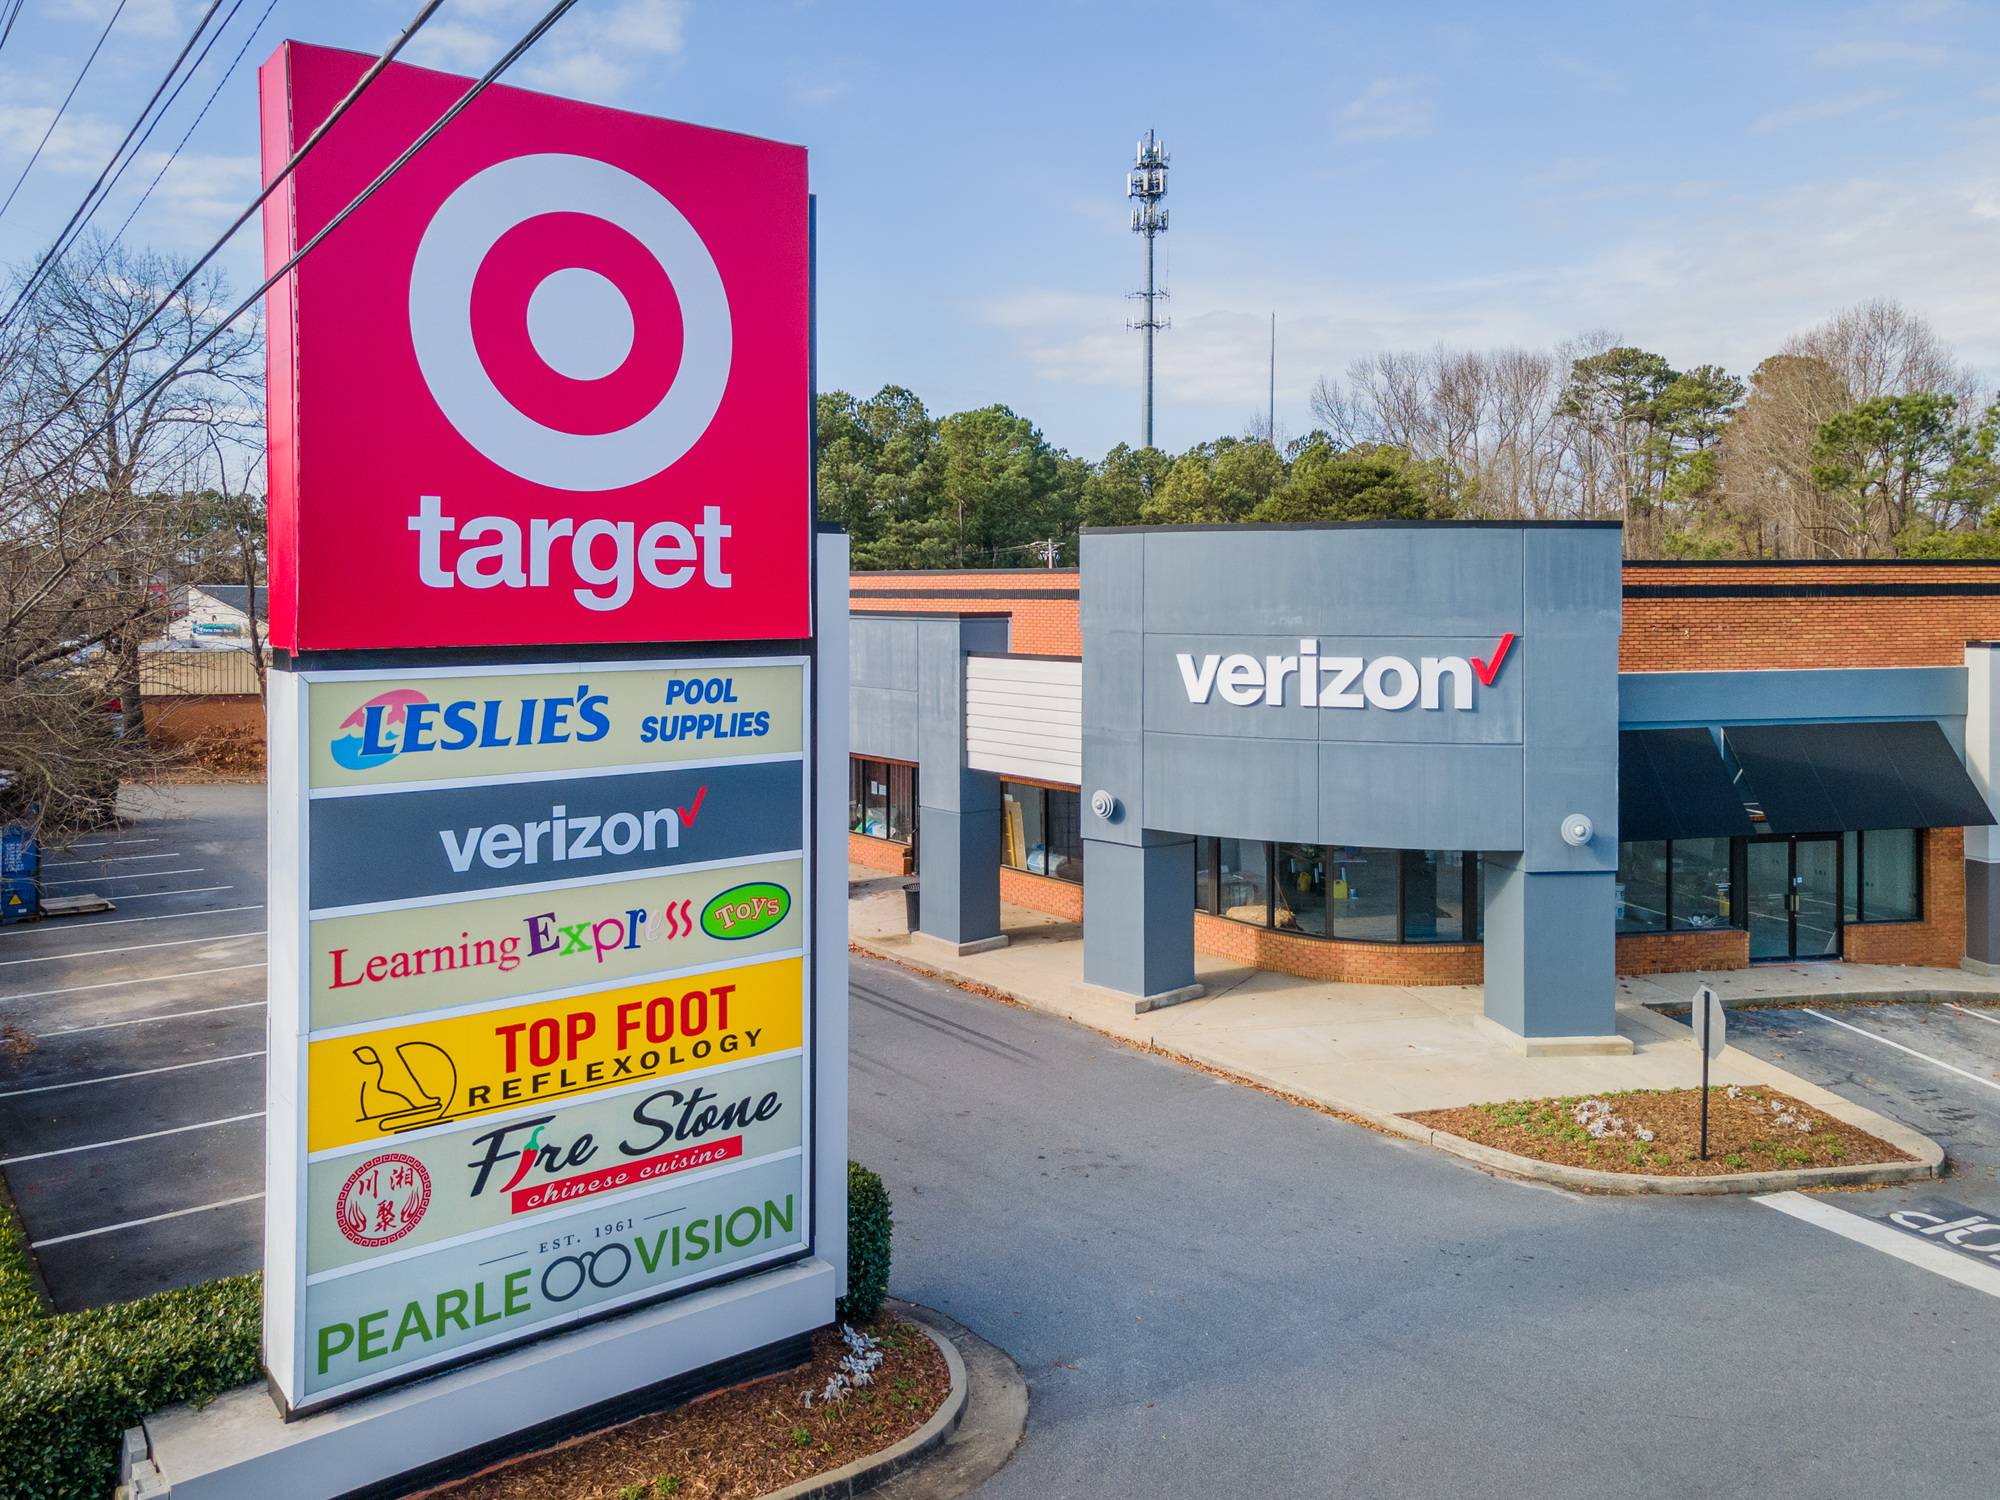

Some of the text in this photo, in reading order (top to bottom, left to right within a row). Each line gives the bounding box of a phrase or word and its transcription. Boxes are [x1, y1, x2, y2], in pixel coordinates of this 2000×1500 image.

[407, 495, 733, 612] target
[665, 677, 738, 705] POOL
[1175, 638, 1473, 710] verizon
[359, 685, 611, 756] LESLIE'S
[639, 710, 770, 744] SUPPLIES
[439, 804, 680, 873] verizon
[328, 896, 781, 990] Learning Express Toys
[495, 984, 737, 1074] TOP FOOT
[468, 1028, 763, 1108] REFLEXOLOGY
[618, 1087, 783, 1156] Stone
[526, 1144, 729, 1208] chinese cuisine
[538, 1217, 635, 1254] EST. 1961
[317, 1193, 794, 1376] PEARLE VISION
